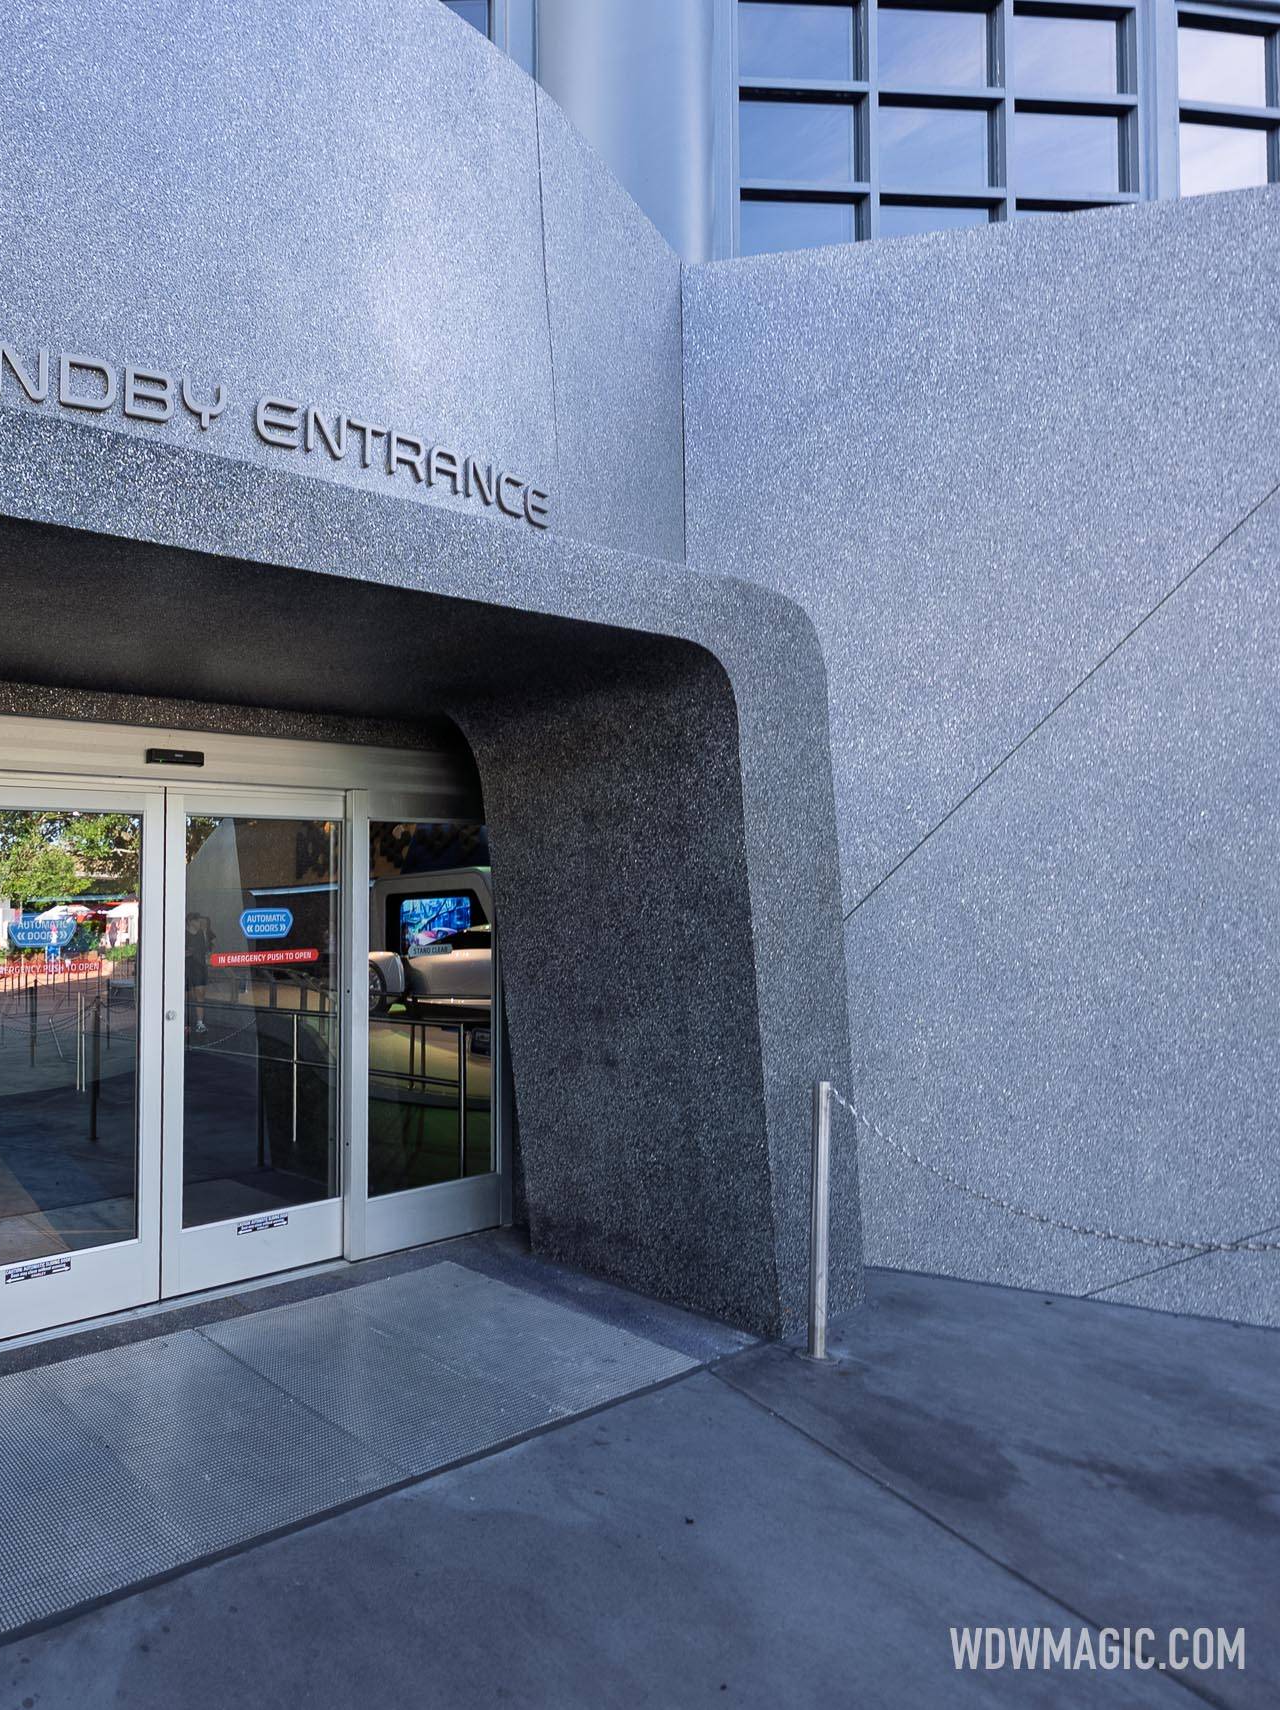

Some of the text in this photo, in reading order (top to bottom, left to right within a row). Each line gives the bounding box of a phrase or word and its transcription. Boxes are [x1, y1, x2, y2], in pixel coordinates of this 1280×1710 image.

[255, 397, 550, 530] ENTRANCE
[247, 914, 286, 922] AUTOMATIC
[17, 919, 68, 930] AUTOMATIC
[254, 924, 279, 932] DOORS
[27, 931, 58, 941] DOOR
[218, 951, 311, 964] IN EMERGENCY PUSH TO OPEN
[43, 963, 64, 973] PUSH
[78, 961, 100, 971] OPEN
